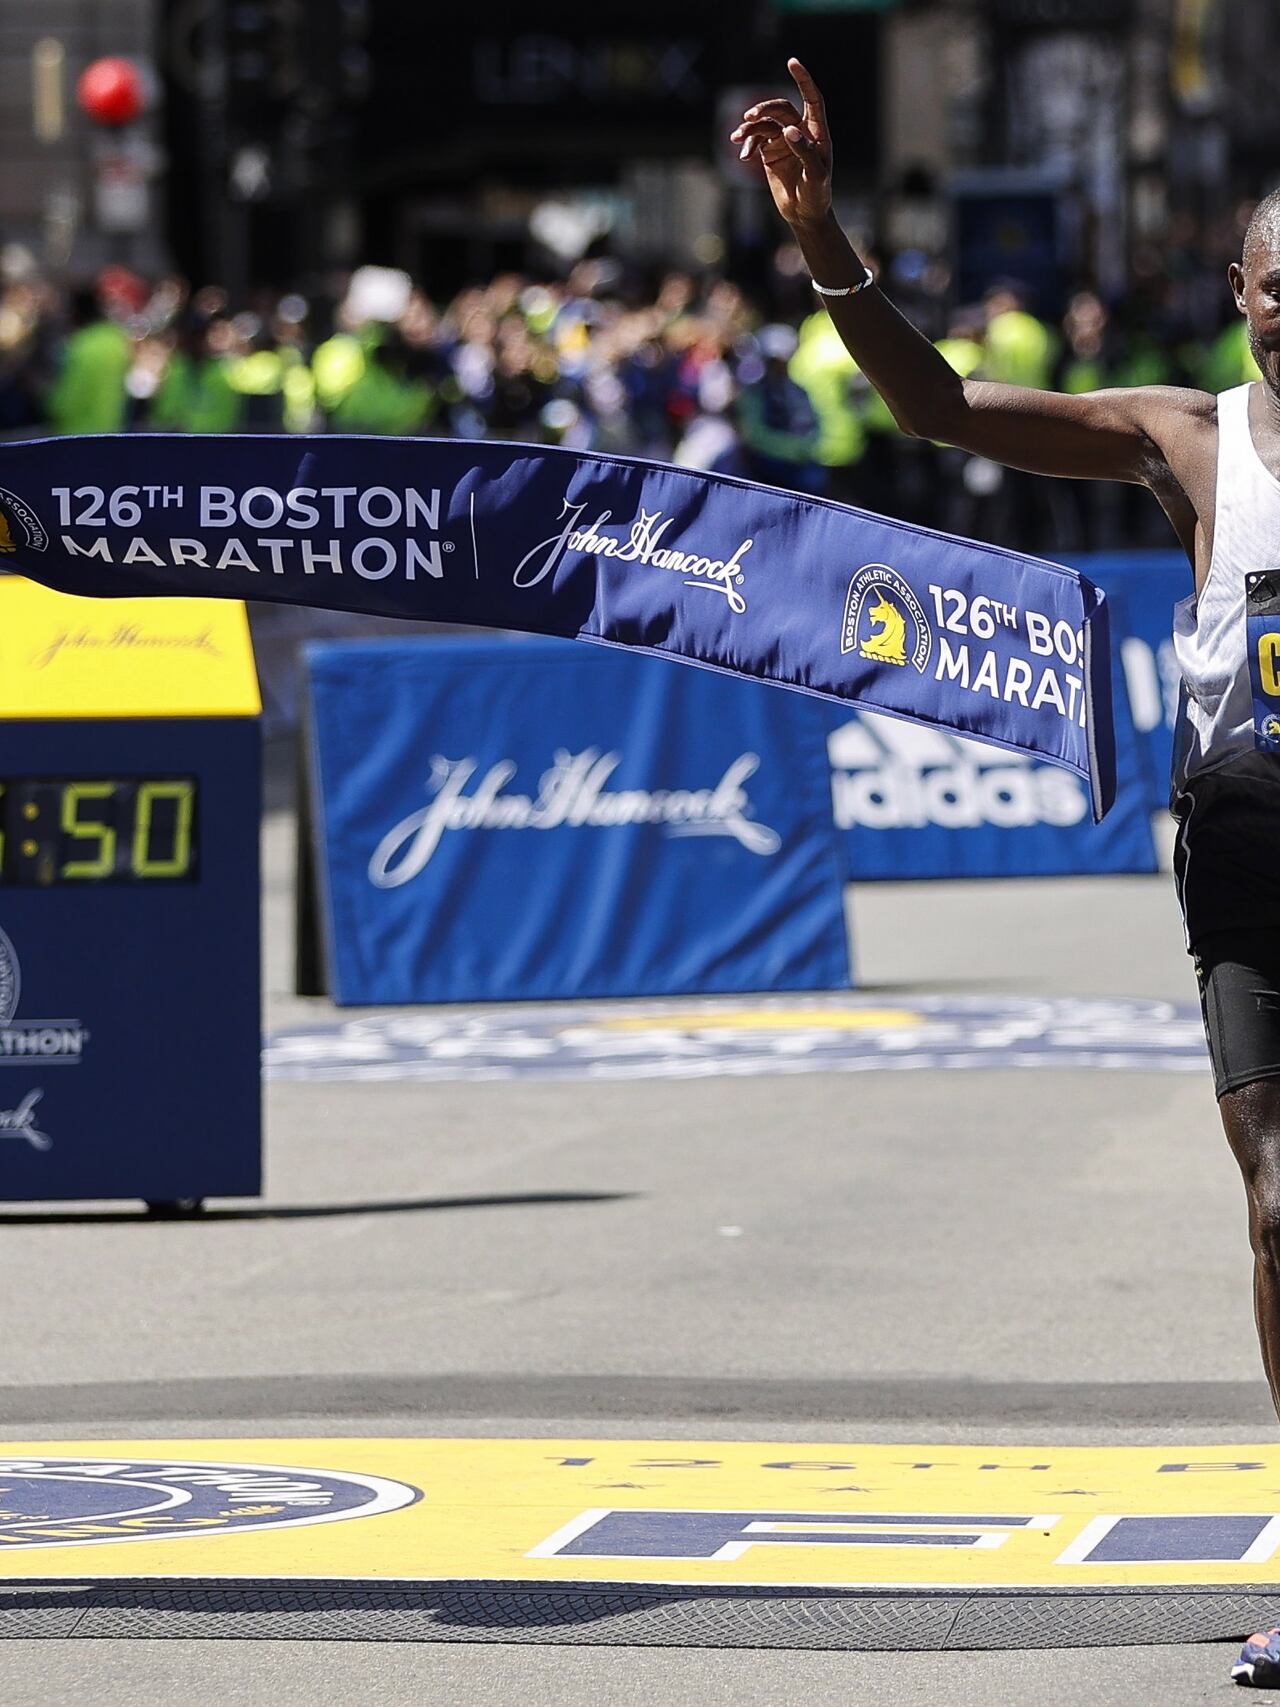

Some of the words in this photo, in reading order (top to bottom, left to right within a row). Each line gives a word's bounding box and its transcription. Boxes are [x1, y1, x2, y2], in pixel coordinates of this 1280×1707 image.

[0, 492, 44, 547] SSOCIATION
[51, 485, 184, 528] 126TH
[200, 486, 442, 531] BOSTON
[512, 497, 619, 589] John
[844, 591, 859, 648] BOSTON
[855, 569, 892, 594] ATHLETIC
[892, 579, 929, 667] ASSOCIATION
[928, 584, 1018, 640] 126TH
[0, 781, 195, 880] :50
[367, 753, 534, 889] John
[528, 745, 783, 856] Hancock
